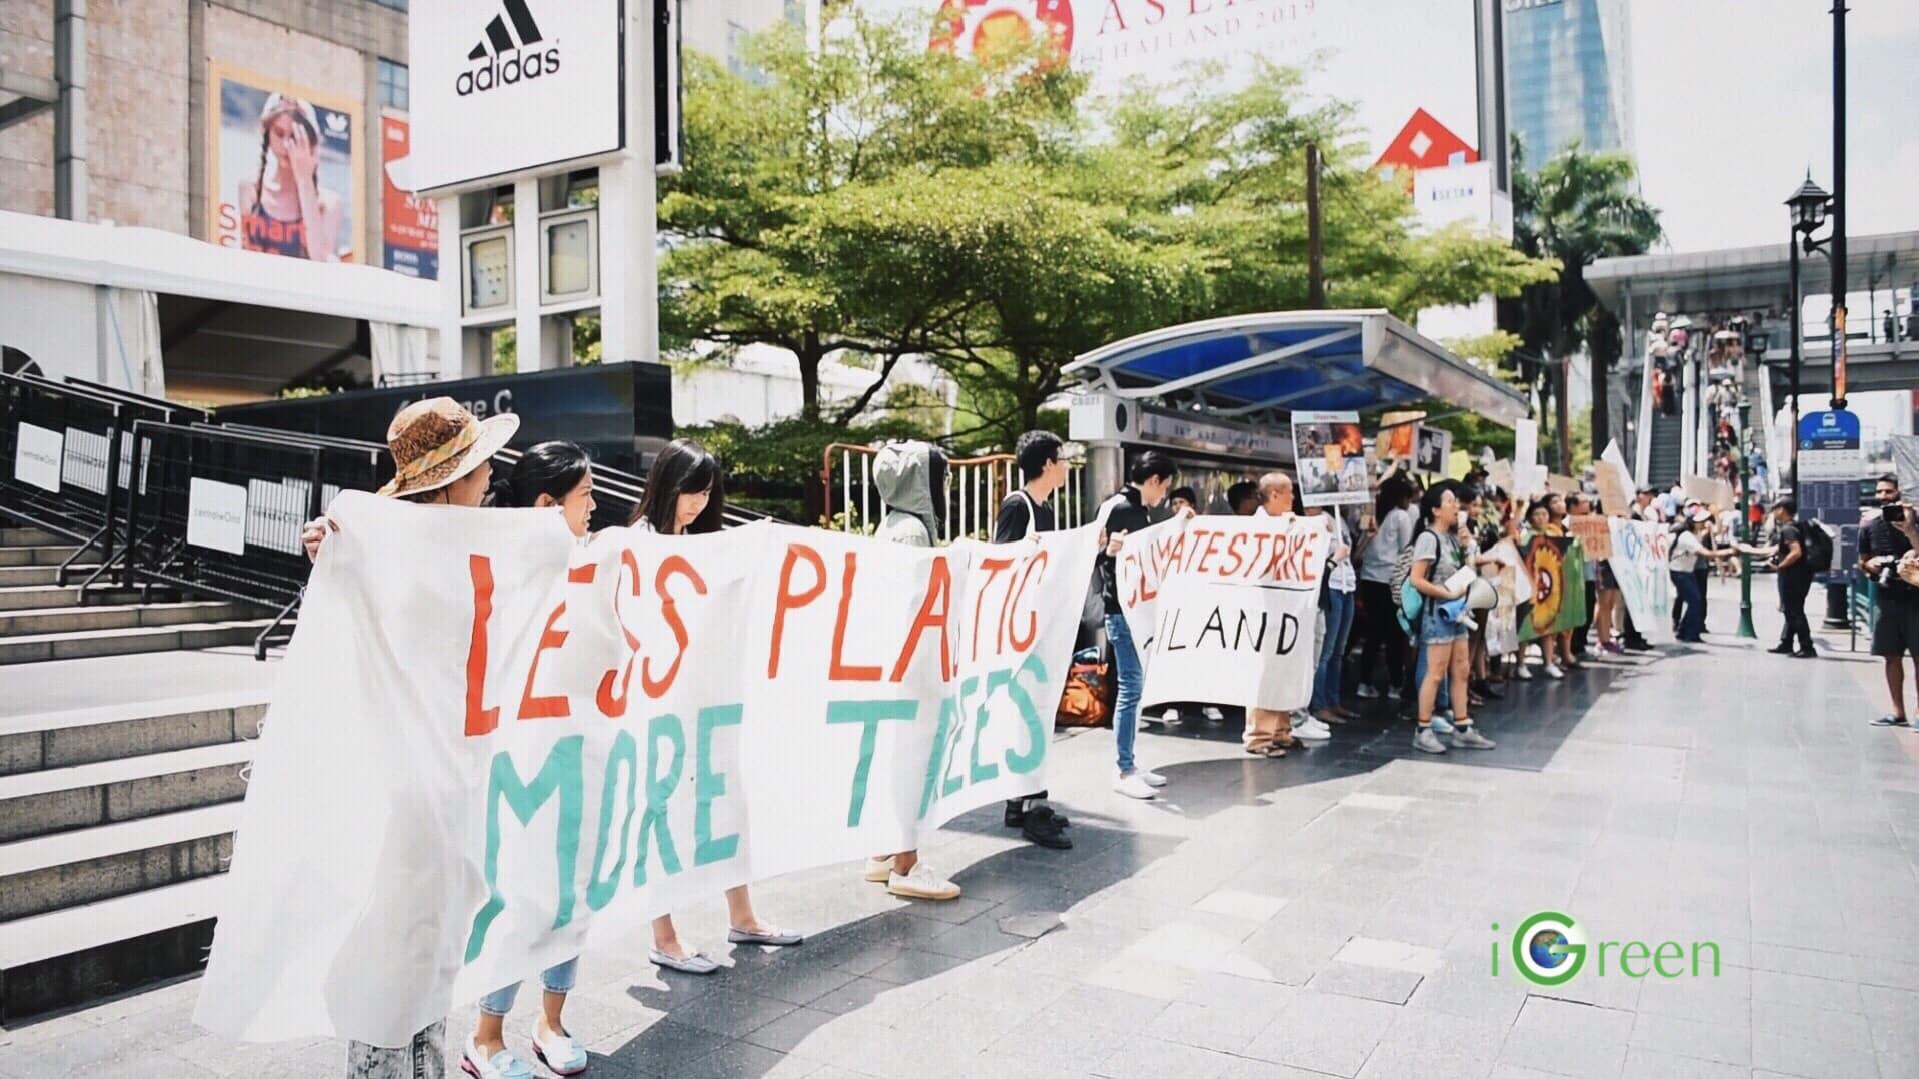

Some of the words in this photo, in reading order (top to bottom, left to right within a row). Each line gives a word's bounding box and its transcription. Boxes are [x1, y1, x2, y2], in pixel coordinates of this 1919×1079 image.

[456, 48, 560, 96] adidas
[464, 548, 707, 737] LESS
[767, 543, 1048, 682] PLATIC
[464, 703, 744, 965] MORE
